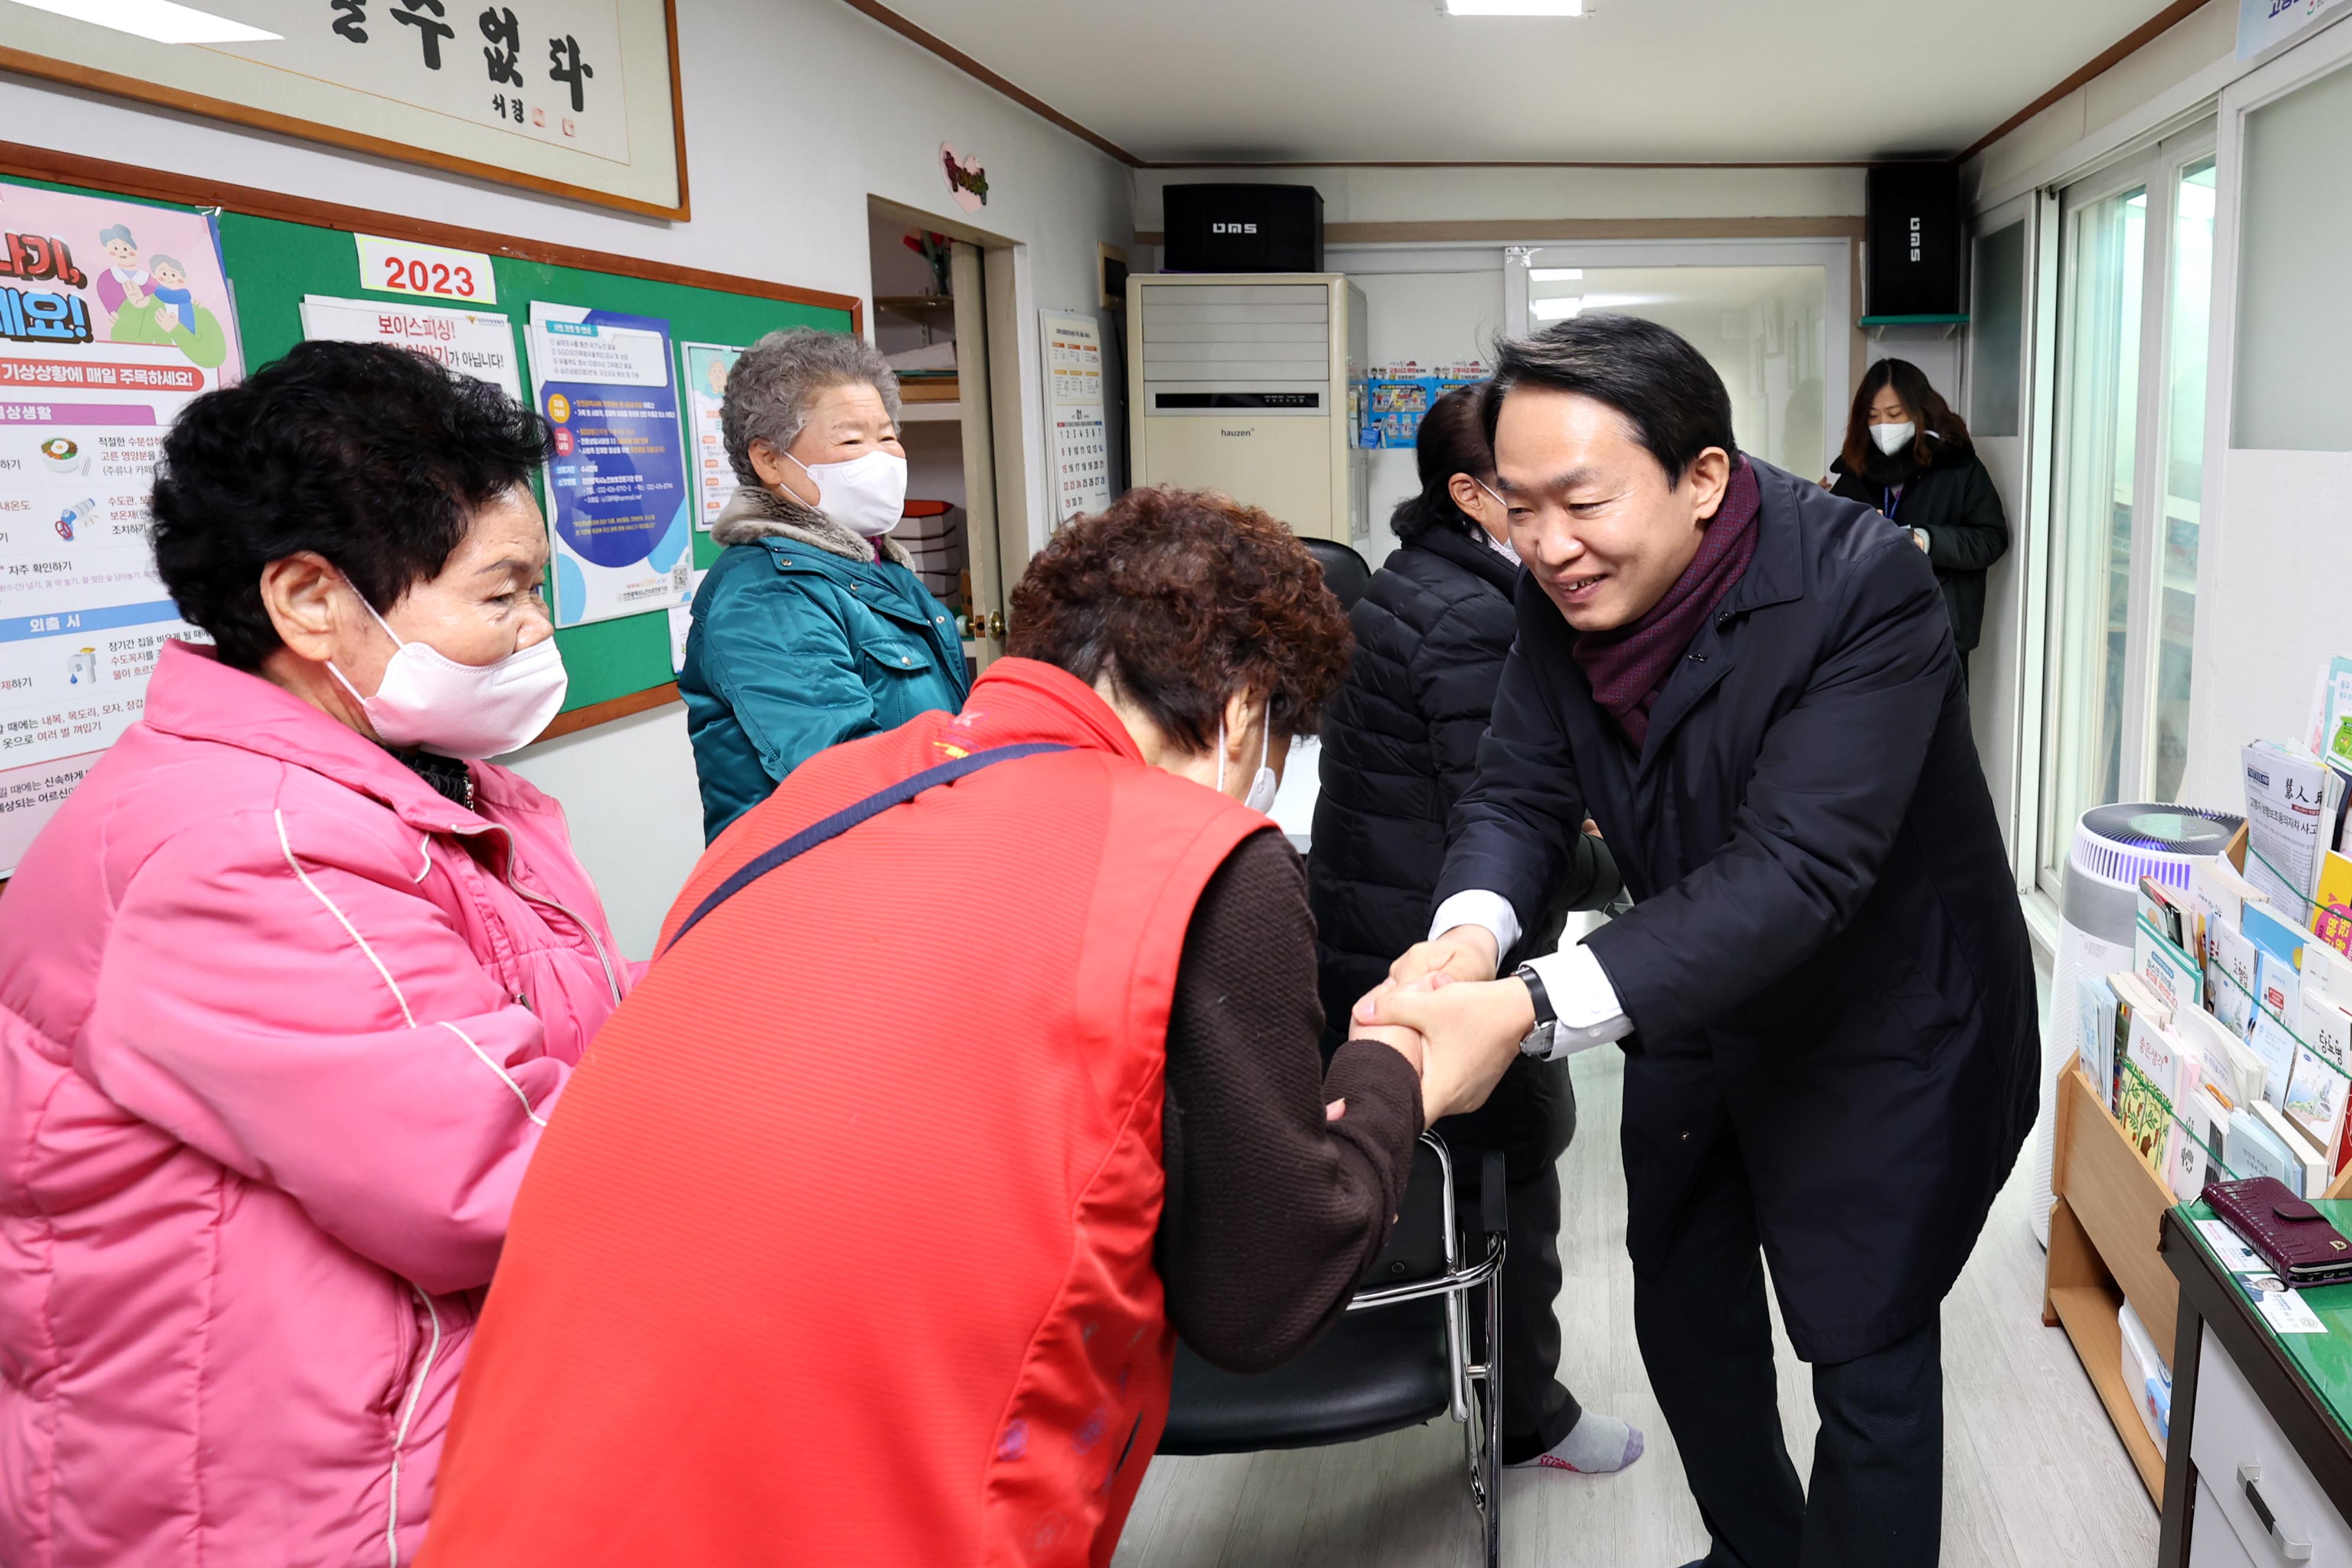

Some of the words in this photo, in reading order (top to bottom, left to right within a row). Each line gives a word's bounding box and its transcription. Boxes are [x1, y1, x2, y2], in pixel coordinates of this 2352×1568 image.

[385, 257, 475, 296] 2023
[378, 315, 456, 341] 보이스피싱!
[462, 351, 504, 368] 아닙니다!
[2, 363, 83, 383] 기상상황에
[86, 367, 117, 384] 매일
[120, 368, 193, 386] 주목하세요!
[1221, 429, 1251, 437] hauzen
[99, 437, 125, 447] 적절한
[102, 451, 119, 461] 고른
[121, 450, 155, 461] 영양분을
[103, 465, 132, 476] (주류나
[136, 465, 155, 475] 카페
[109, 496, 137, 507] 수도관,
[112, 524, 147, 534] 조치하기
[9, 565, 29, 576] 자주
[33, 561, 72, 573] 확인하기
[30, 616, 60, 632] 외출
[67, 613, 80, 628] 시
[109, 639, 135, 652] 장기간
[138, 636, 154, 648] 집을
[110, 650, 153, 666] 수도꼭지를
[113, 668, 131, 680] 물이
[8, 719, 38, 732] 때에는
[42, 714, 65, 726] 내복,
[68, 707, 100, 721] 목도리,
[103, 703, 123, 714] 모자,
[126, 698, 143, 710] 장갑
[2, 734, 34, 749] 옷으로
[38, 730, 57, 741] 여러
[61, 727, 70, 738] 벌
[11, 781, 42, 795] 때에는
[45, 770, 84, 788] 신속하게
[2140, 1036, 2164, 1072] 좋은생각
